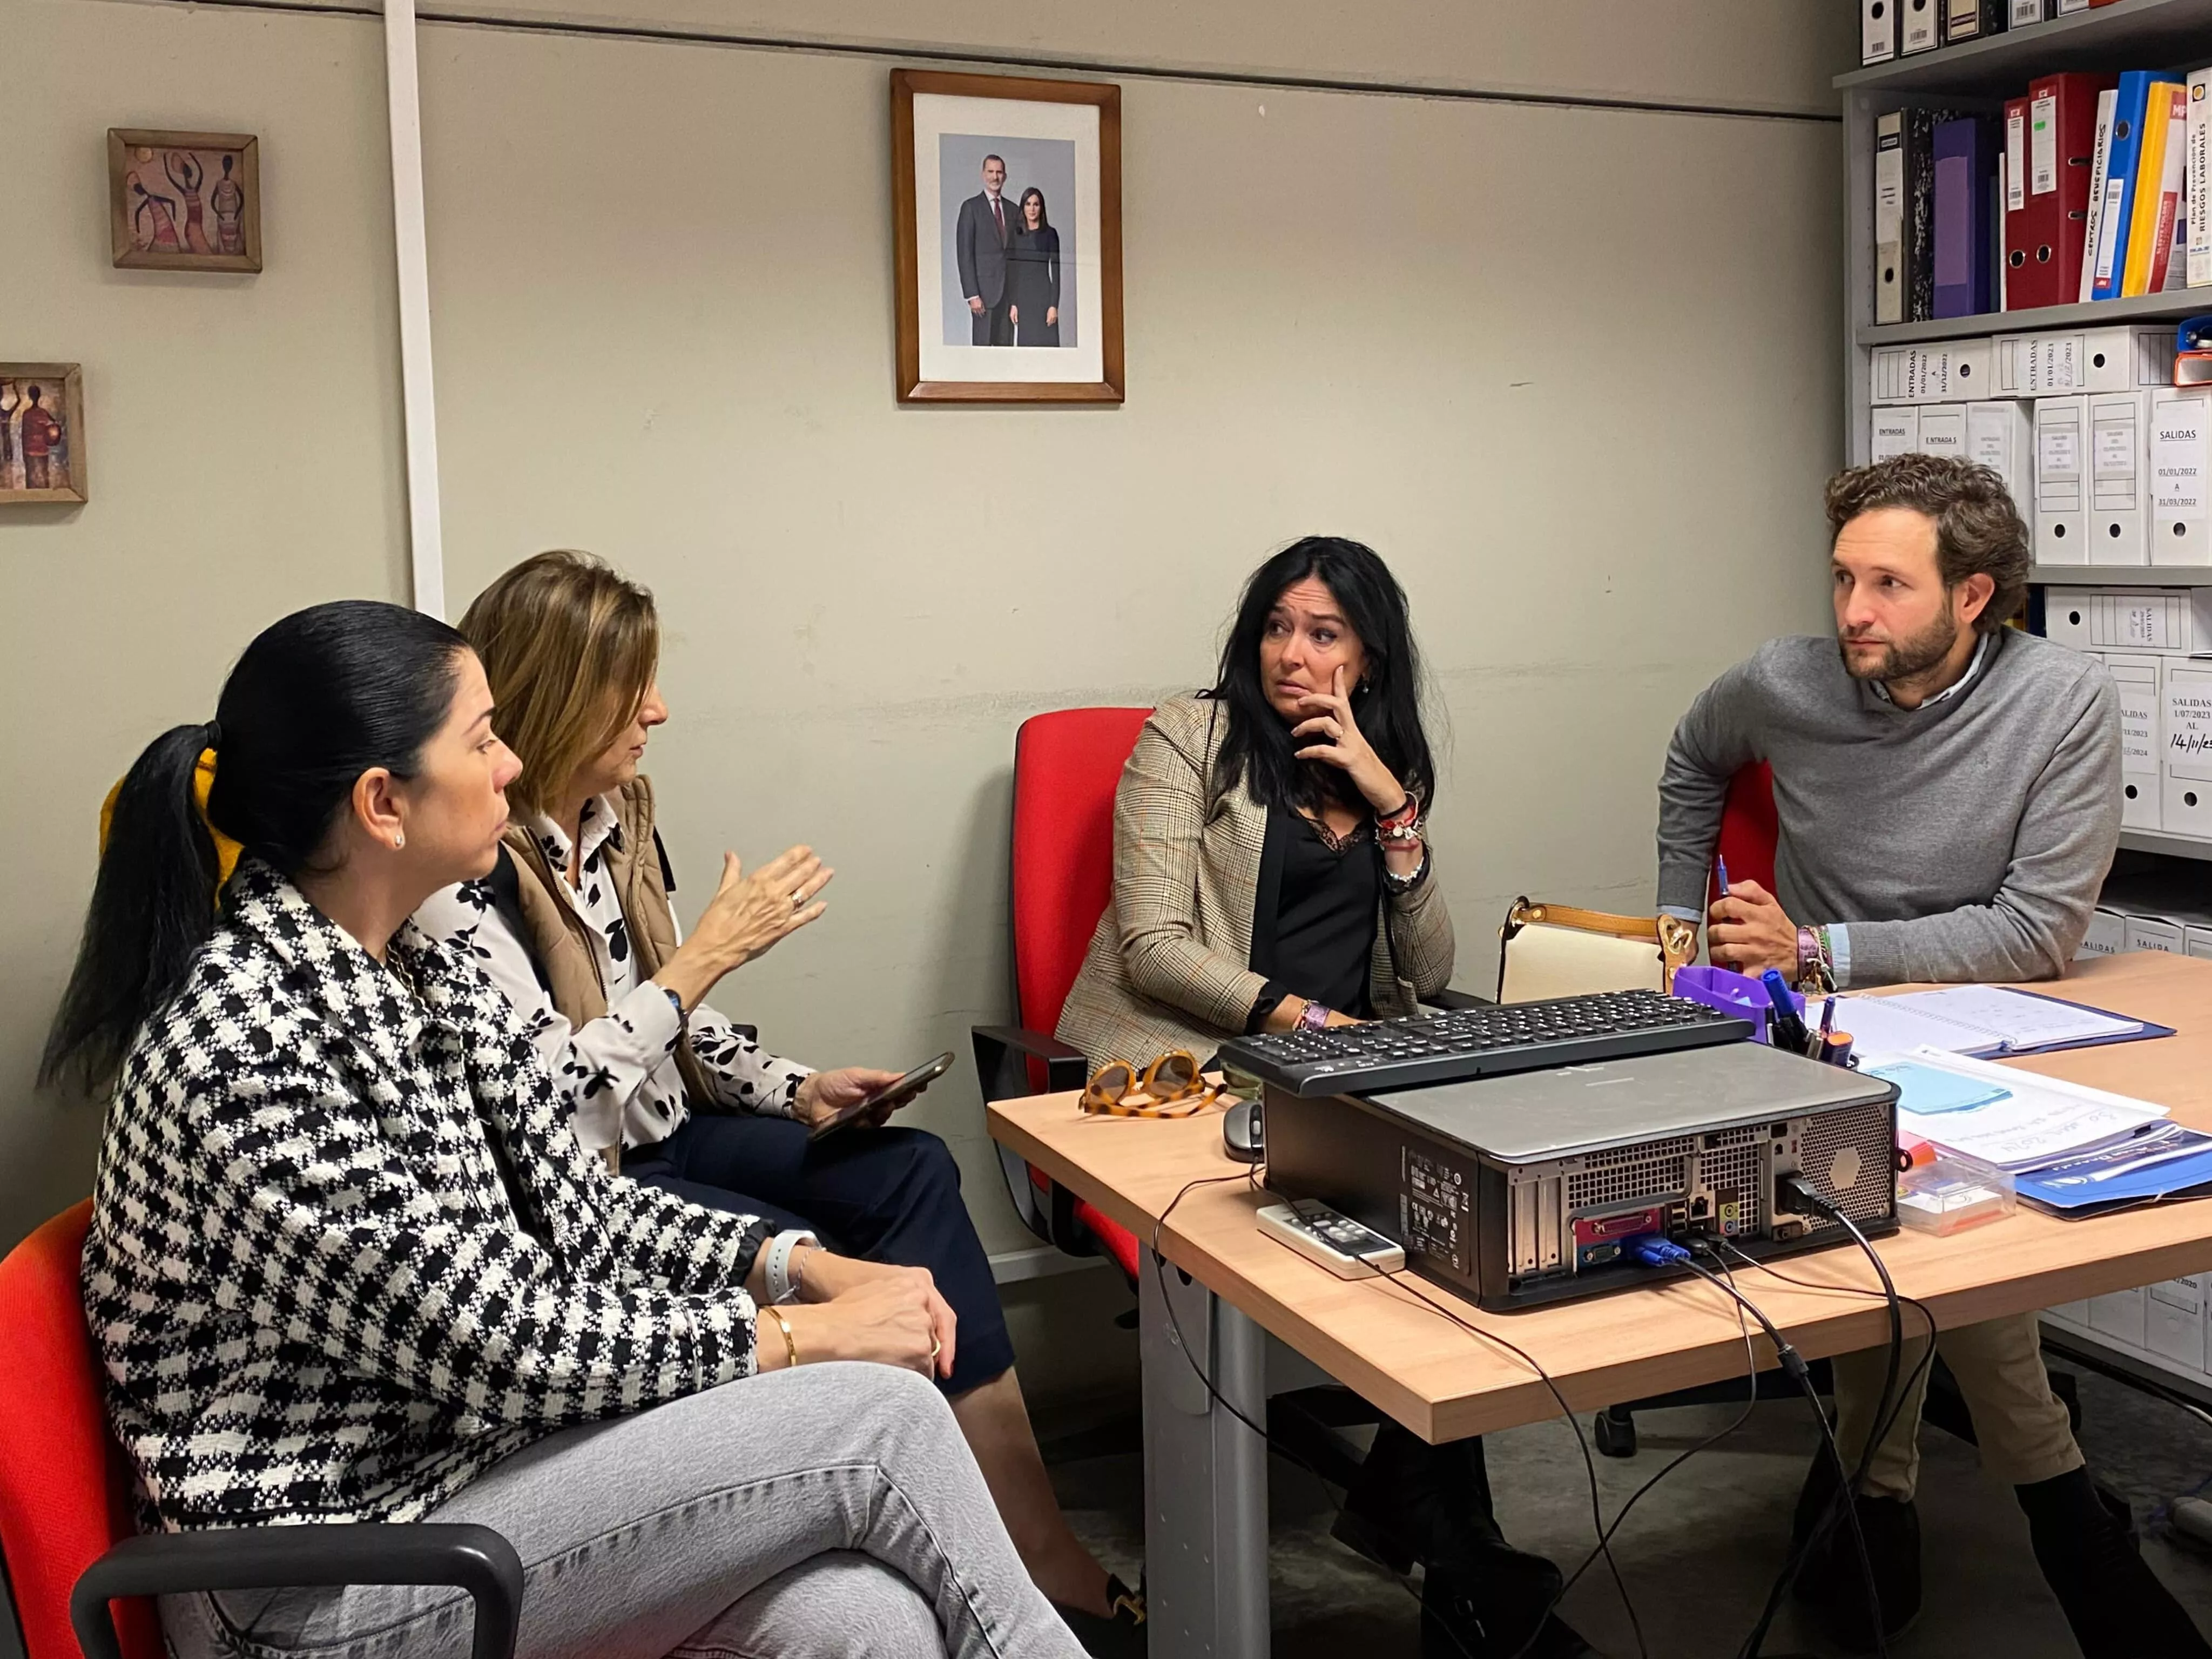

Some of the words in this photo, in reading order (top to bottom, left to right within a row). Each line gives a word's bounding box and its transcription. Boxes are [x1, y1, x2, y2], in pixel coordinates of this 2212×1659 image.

[2088, 210, 2098, 257] CENTROS
[2093, 124, 2107, 202] BENEFICIARIOS
[1908, 350, 1917, 398] ENTRADAS
[2160, 430, 2196, 440] SALIDAS
[2158, 468, 2197, 476] 01/01/2022
[2172, 698, 2211, 707] SALIDAS
[2121, 709, 2148, 719] ALIDAS
[2081, 941, 2115, 953] ALIDAS
